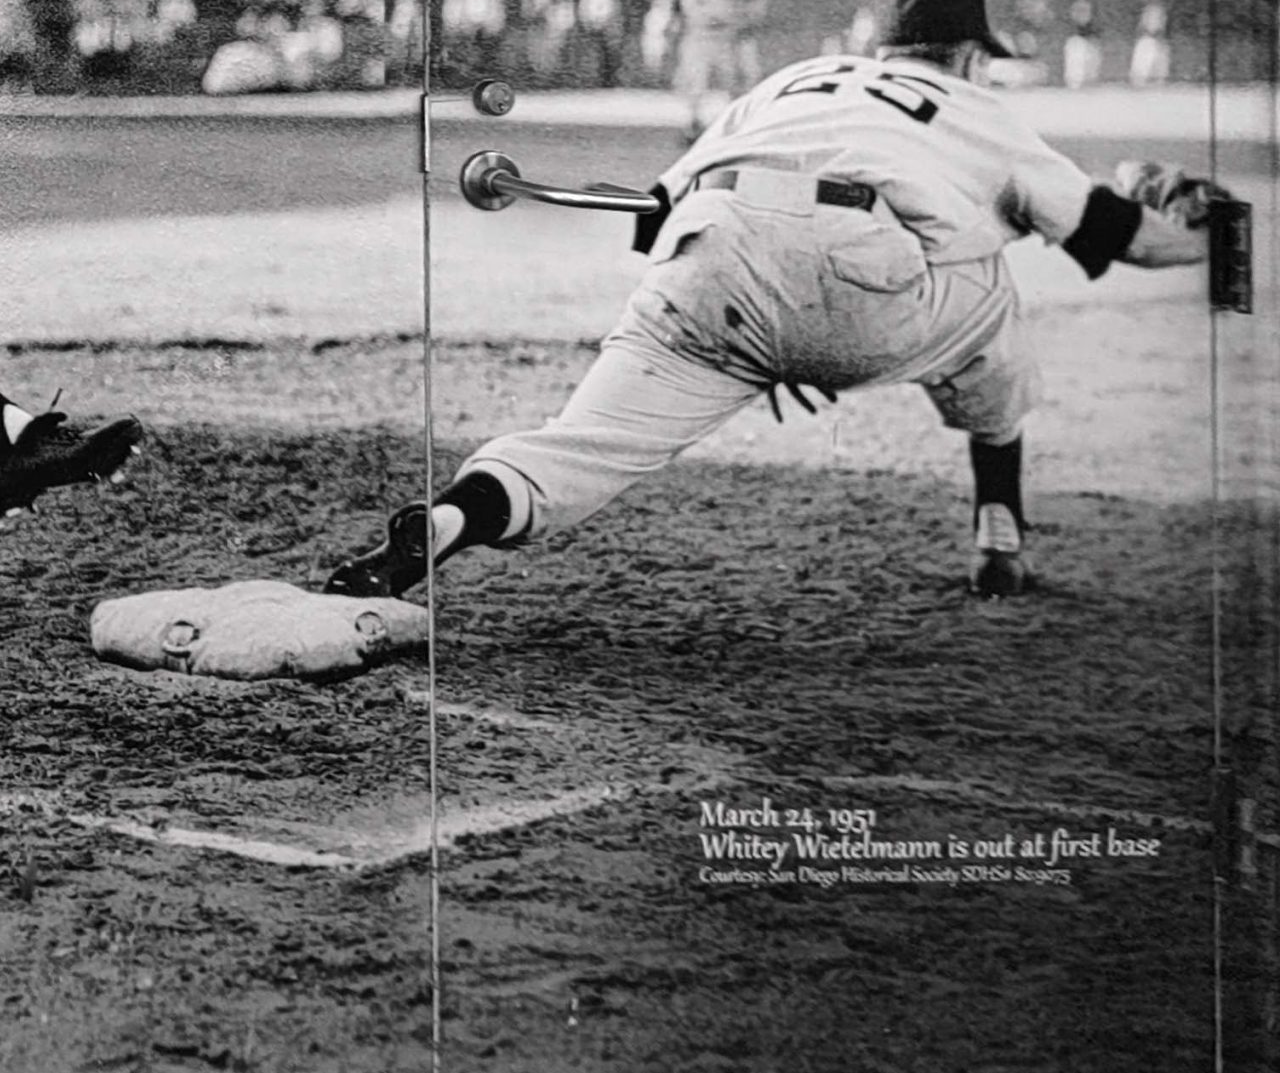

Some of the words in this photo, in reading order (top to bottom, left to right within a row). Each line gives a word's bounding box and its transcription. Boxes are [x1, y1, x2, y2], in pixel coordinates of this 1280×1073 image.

[699, 797, 780, 827] March
[785, 807, 821, 832] 24,
[829, 809, 876, 833] 1951
[699, 830, 789, 869] Whitey
[792, 830, 942, 858] Wietelmann
[948, 833, 969, 858] is
[973, 833, 1015, 858] out
[1020, 833, 1045, 857] at
[1044, 828, 1101, 866] first
[1108, 828, 1161, 856] base
[767, 868, 797, 883] San
[798, 866, 840, 888] Diego
[841, 864, 909, 883] Historical
